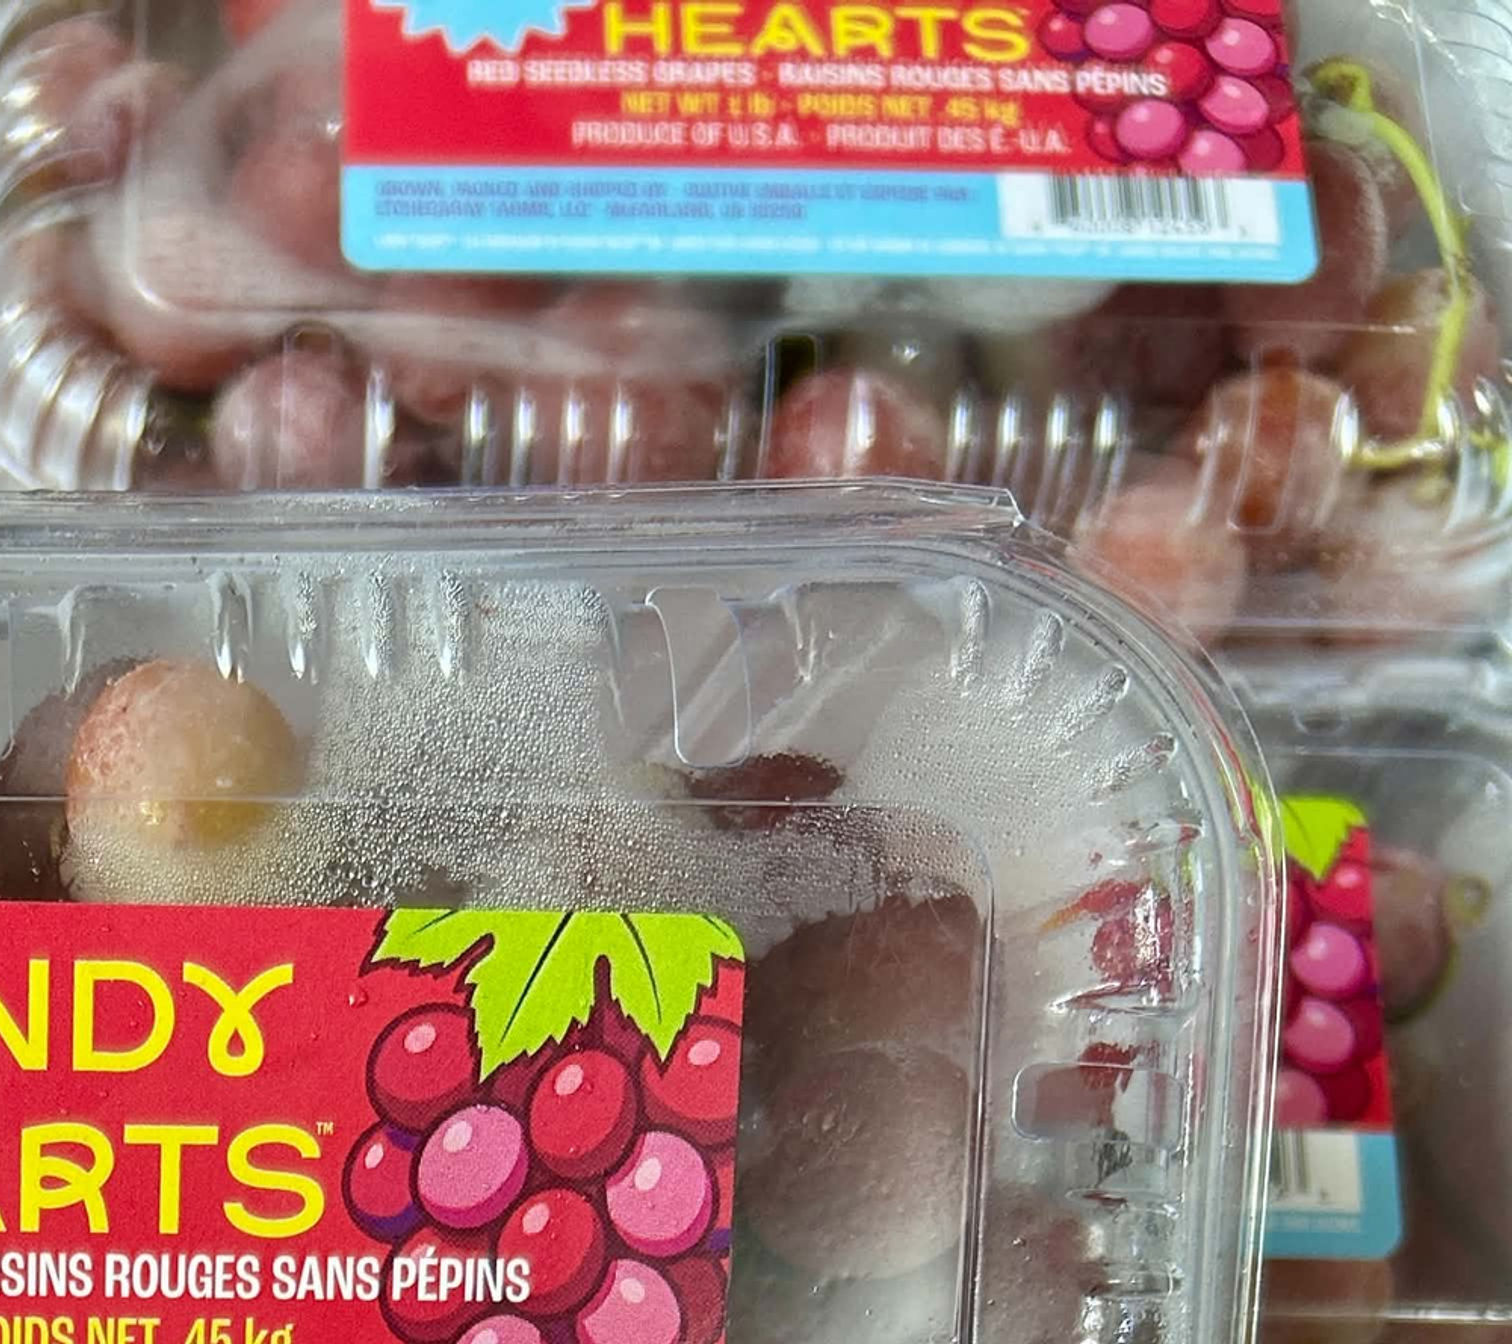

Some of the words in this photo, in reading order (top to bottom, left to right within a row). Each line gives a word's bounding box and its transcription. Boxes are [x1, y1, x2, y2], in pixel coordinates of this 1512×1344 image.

[105, 1253, 260, 1300] ROUGES
[273, 1255, 380, 1302] SANS
[391, 1247, 531, 1304] PÉPINS
